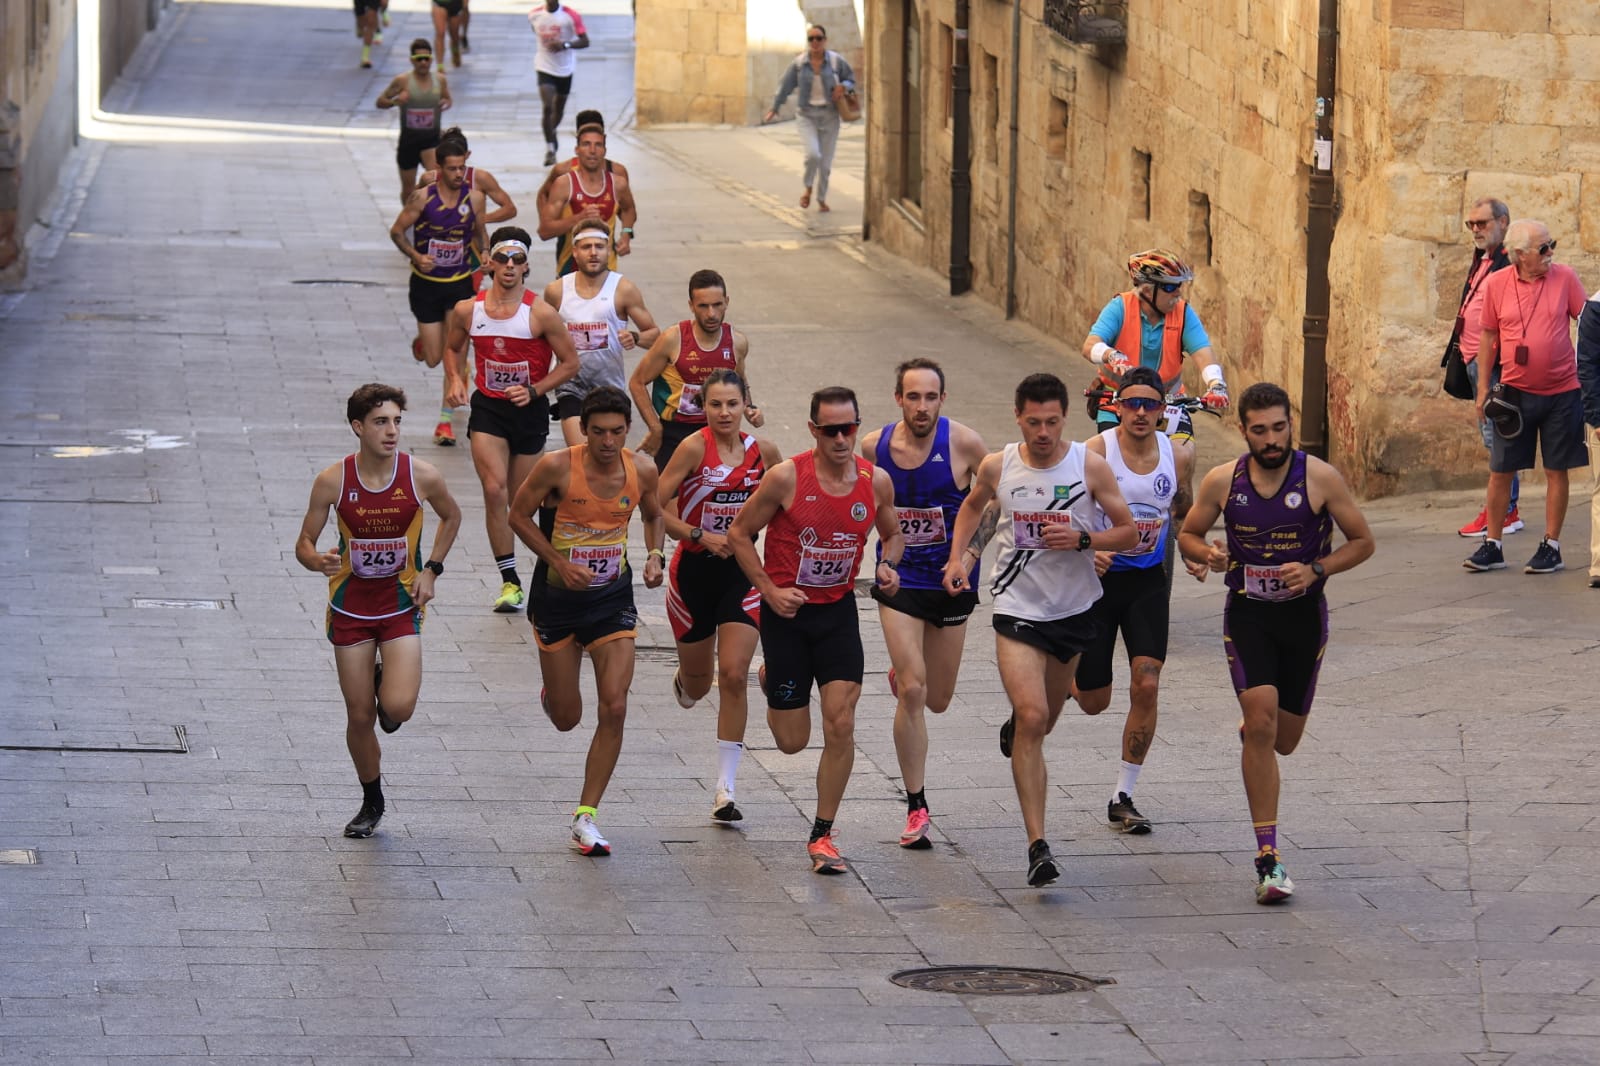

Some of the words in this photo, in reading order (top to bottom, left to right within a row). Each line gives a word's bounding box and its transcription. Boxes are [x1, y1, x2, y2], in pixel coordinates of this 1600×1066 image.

[436, 249, 457, 259] 507
[584, 331, 590, 342] 1
[494, 371, 520, 383] 224
[704, 505, 741, 516] bedu
[897, 510, 942, 519] edunia
[373, 525, 400, 533] TORO
[900, 520, 933, 534] 292
[351, 541, 407, 552] bedunia
[572, 547, 622, 559] bedunia
[804, 550, 856, 561] bedunia
[362, 552, 396, 567] 243
[588, 559, 608, 574] 52
[811, 561, 843, 576] 324
[1246, 567, 1281, 577] bedu
